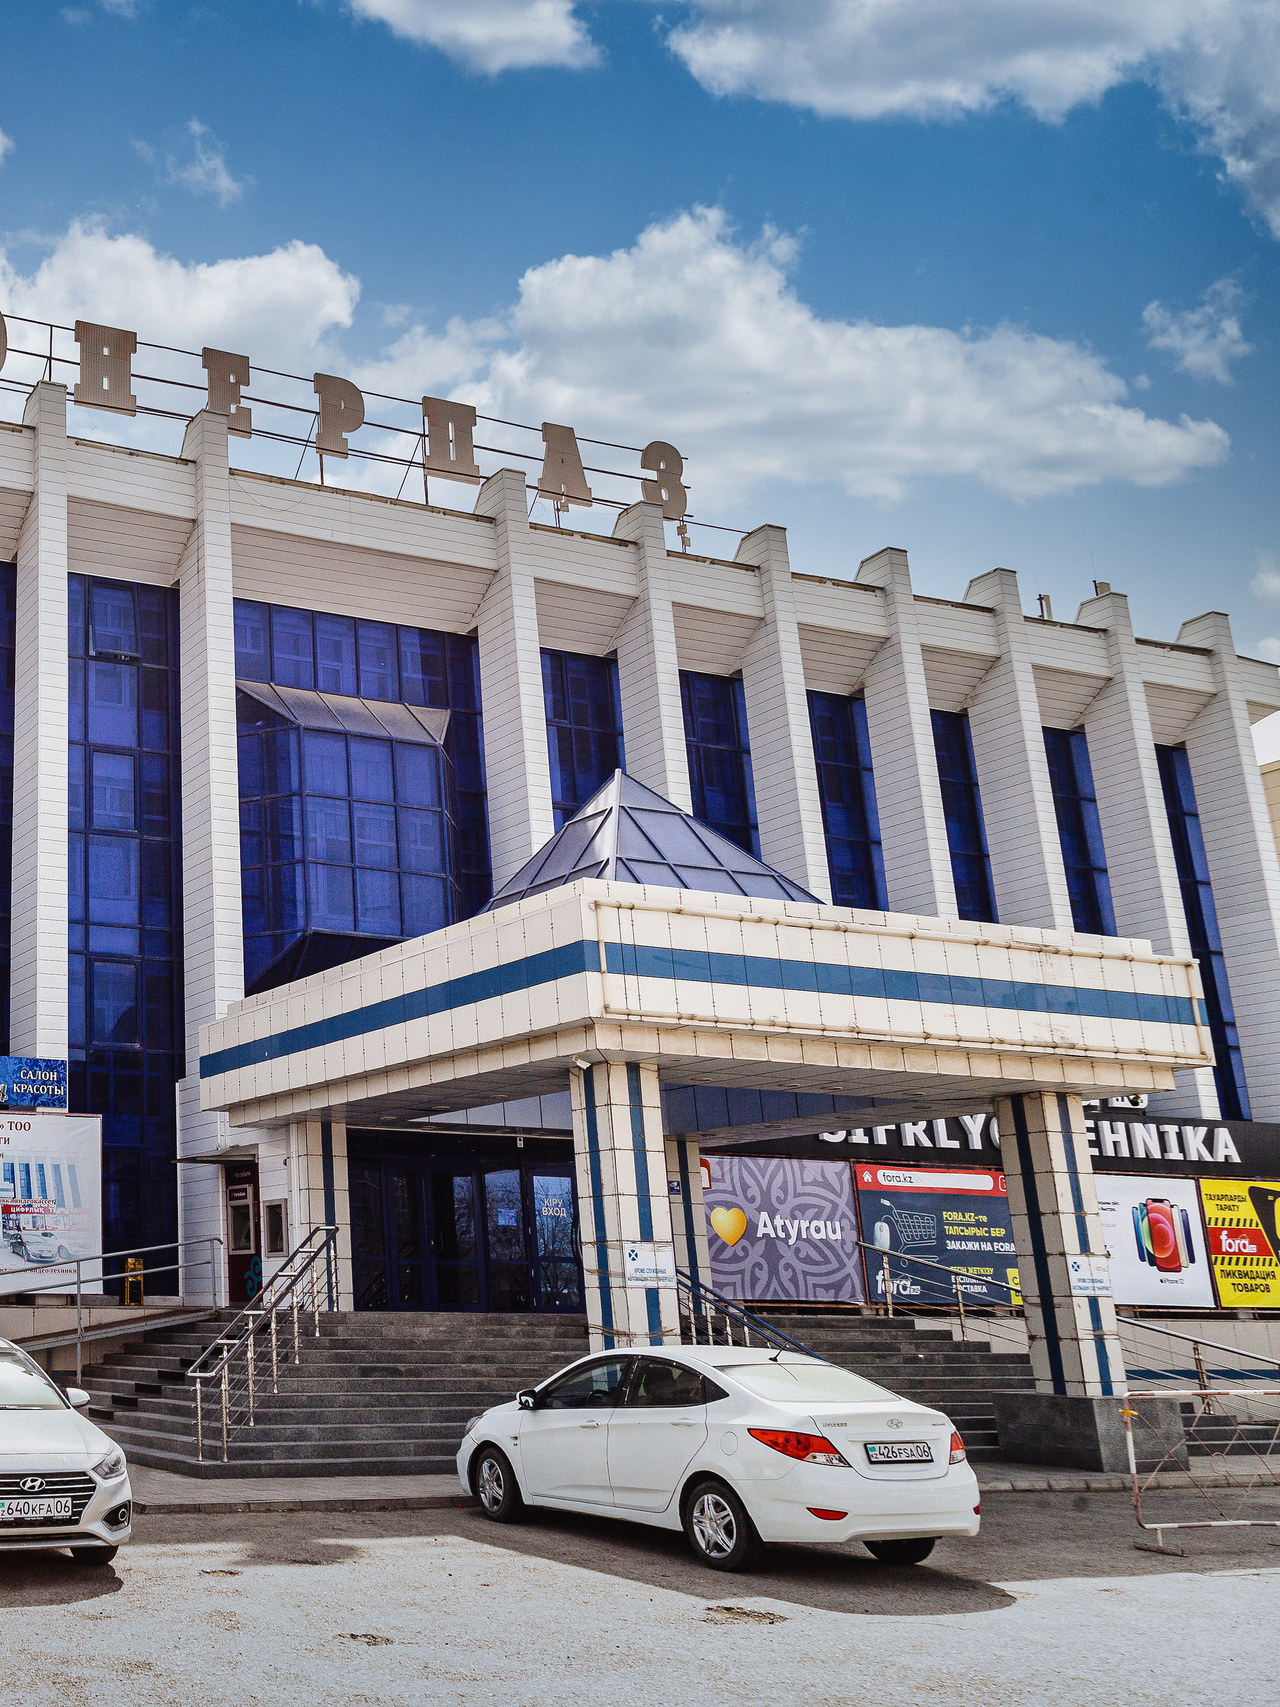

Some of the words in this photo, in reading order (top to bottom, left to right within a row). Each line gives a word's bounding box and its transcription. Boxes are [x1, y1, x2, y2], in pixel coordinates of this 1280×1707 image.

[20, 1070, 57, 1081] САЛОН
[13, 1083, 64, 1095] КРАСОТЫ
[7, 1120, 31, 1131] ТОО
[882, 1172, 914, 1184] fora.kz
[544, 1198, 562, 1207] КІРУ
[542, 1207, 566, 1217] ВХОД
[756, 1212, 842, 1246] Atyrau
[944, 1225, 989, 1237] ТАПСЫРЫС
[990, 1228, 1006, 1237] БЕР
[946, 1240, 979, 1251] ЗАКАЖИ
[980, 1243, 993, 1252] НА
[1220, 1230, 1249, 1253] fora
[1220, 1269, 1277, 1281] ЛИКВИДАЦИЯ
[1231, 1283, 1271, 1293] ТОВАРОВ
[916, 1445, 929, 1457] 06
[55, 1500, 70, 1514] 06
